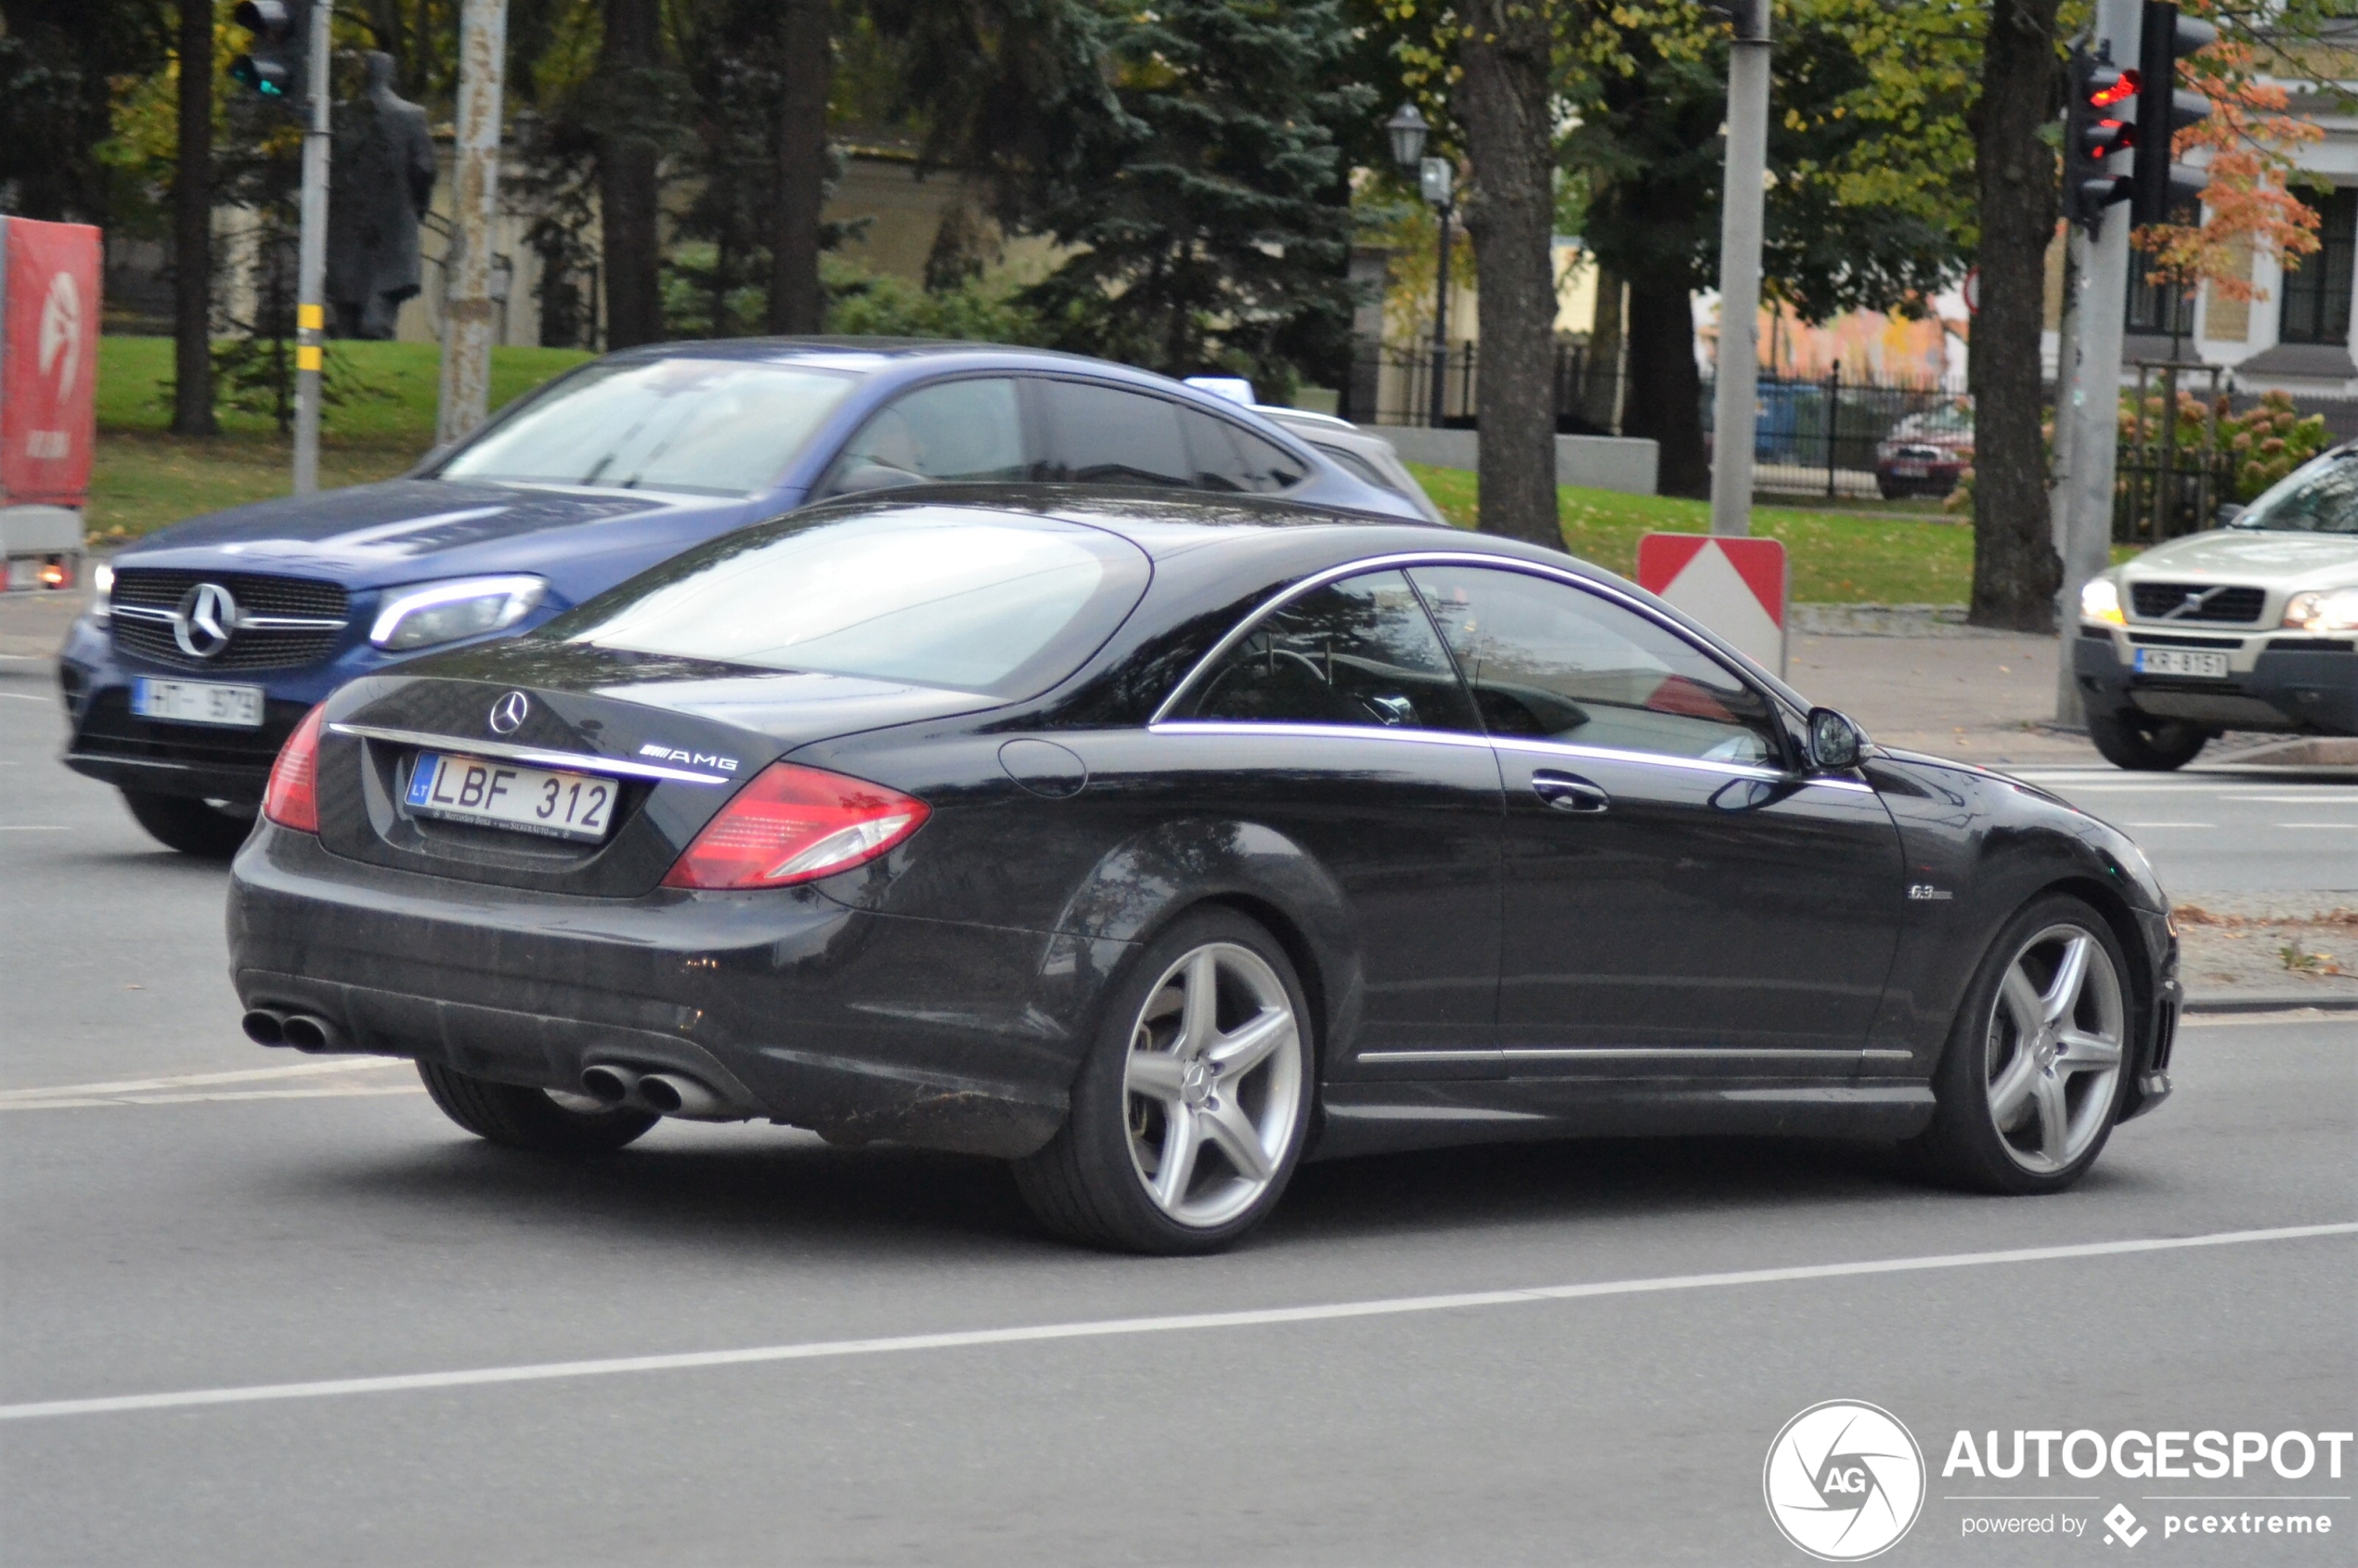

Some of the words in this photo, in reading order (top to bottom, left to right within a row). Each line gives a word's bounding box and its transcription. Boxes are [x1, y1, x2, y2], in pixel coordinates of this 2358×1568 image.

[668, 749, 739, 771] AMG
[411, 784, 428, 797] LT
[431, 760, 517, 810] LBF
[536, 777, 608, 828] 312
